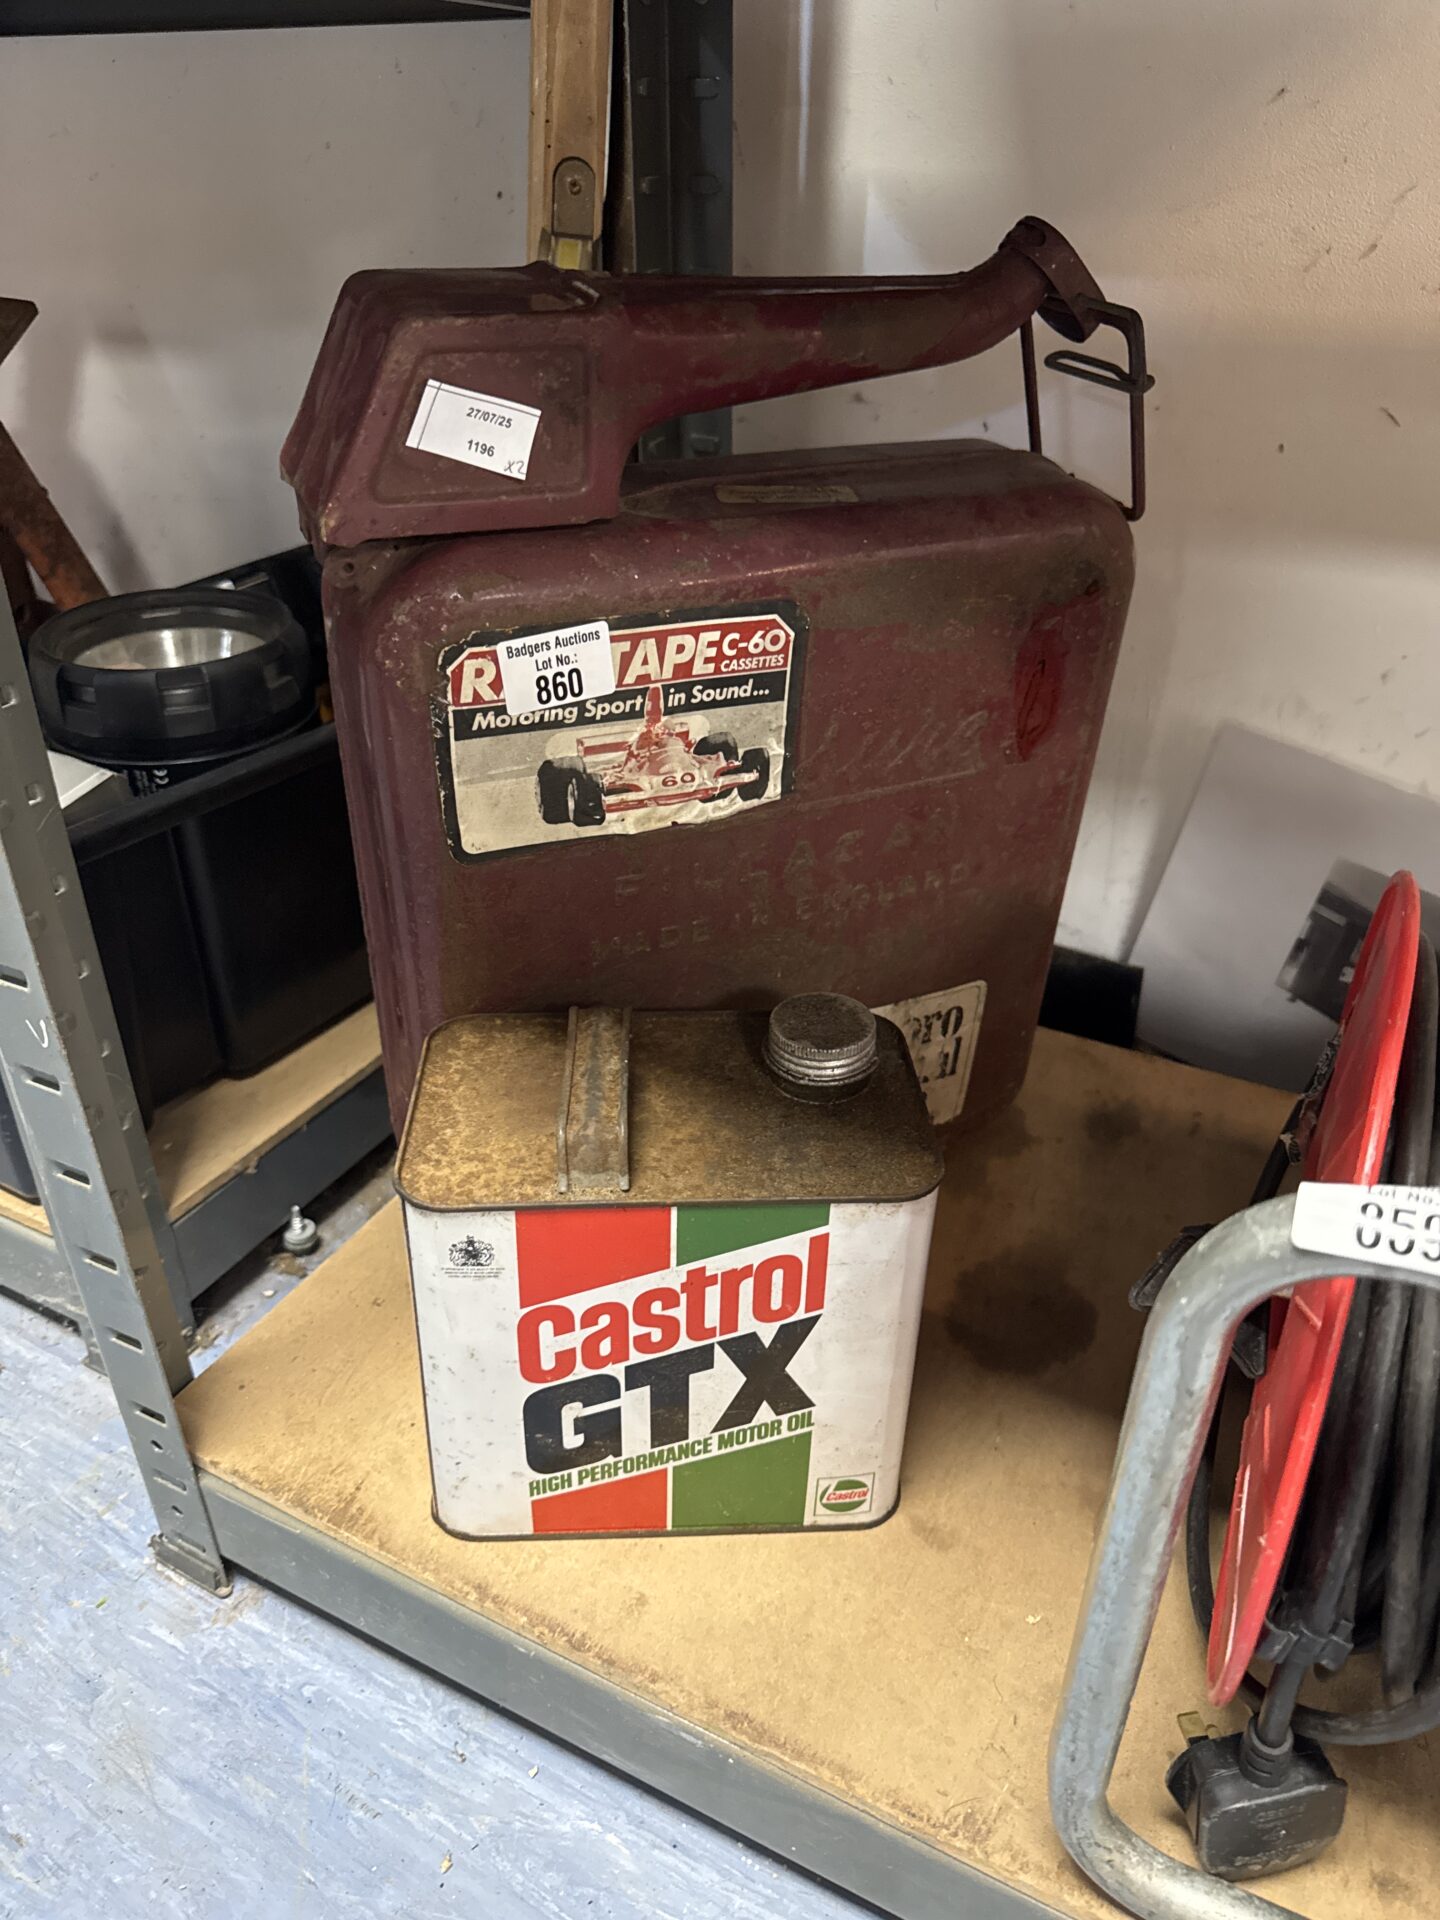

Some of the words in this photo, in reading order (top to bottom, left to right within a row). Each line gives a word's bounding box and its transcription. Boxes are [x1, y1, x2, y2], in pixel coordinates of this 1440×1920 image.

[466, 407, 512, 429] 27/07/25
[467, 439, 495, 457] 1196
[506, 641, 552, 660] Badgers
[554, 629, 601, 649] Auctions
[722, 628, 786, 656] C-60
[535, 657, 553, 672] Lot
[556, 652, 578, 667] No.:
[720, 653, 785, 673] CASSETTES
[535, 667, 584, 705] 860
[471, 703, 578, 732] Motoring
[584, 695, 644, 721] Sport
[667, 687, 686, 708] in
[691, 678, 770, 704] Sound...
[661, 772, 696, 787] 60
[516, 1232, 830, 1384] Castrol
[522, 1313, 824, 1475] GTX
[529, 1471, 573, 1497] HIGH
[577, 1436, 713, 1485] PERFORMANCE
[717, 1418, 783, 1450] MOTOR
[787, 1409, 815, 1432] OIL
[826, 1488, 869, 1502] Castrol
